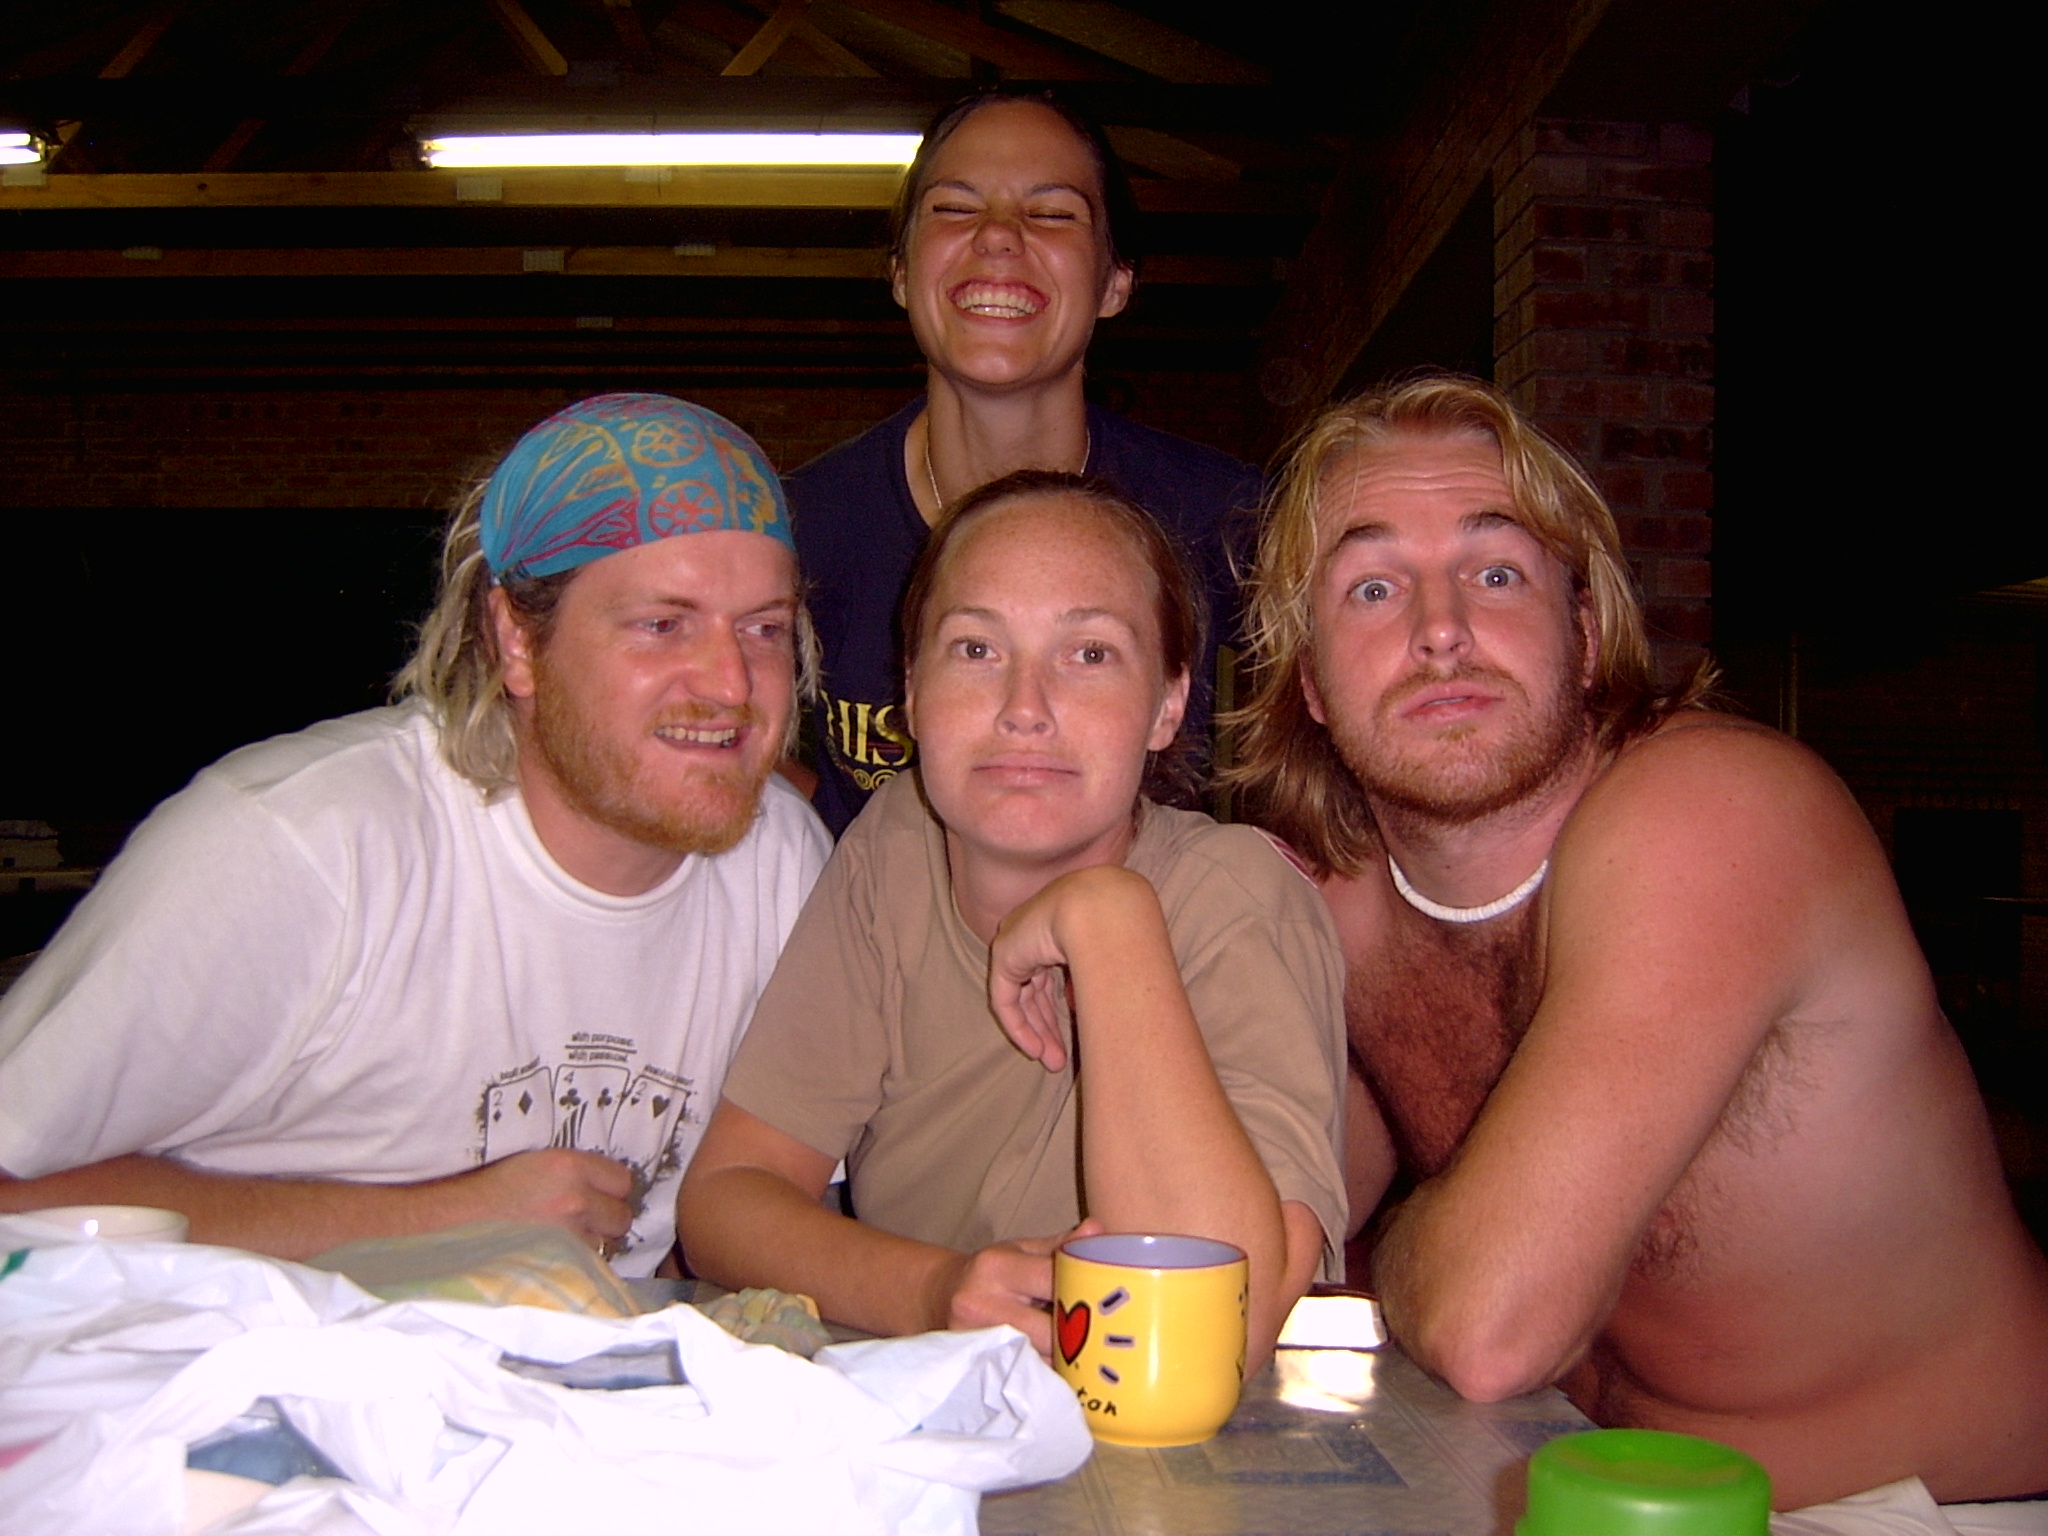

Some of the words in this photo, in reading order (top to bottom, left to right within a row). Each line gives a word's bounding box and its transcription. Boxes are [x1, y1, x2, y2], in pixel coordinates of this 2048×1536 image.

[564, 1071, 574, 1084] 4
[636, 1081, 648, 1095] 2
[493, 1090, 503, 1106] 2
